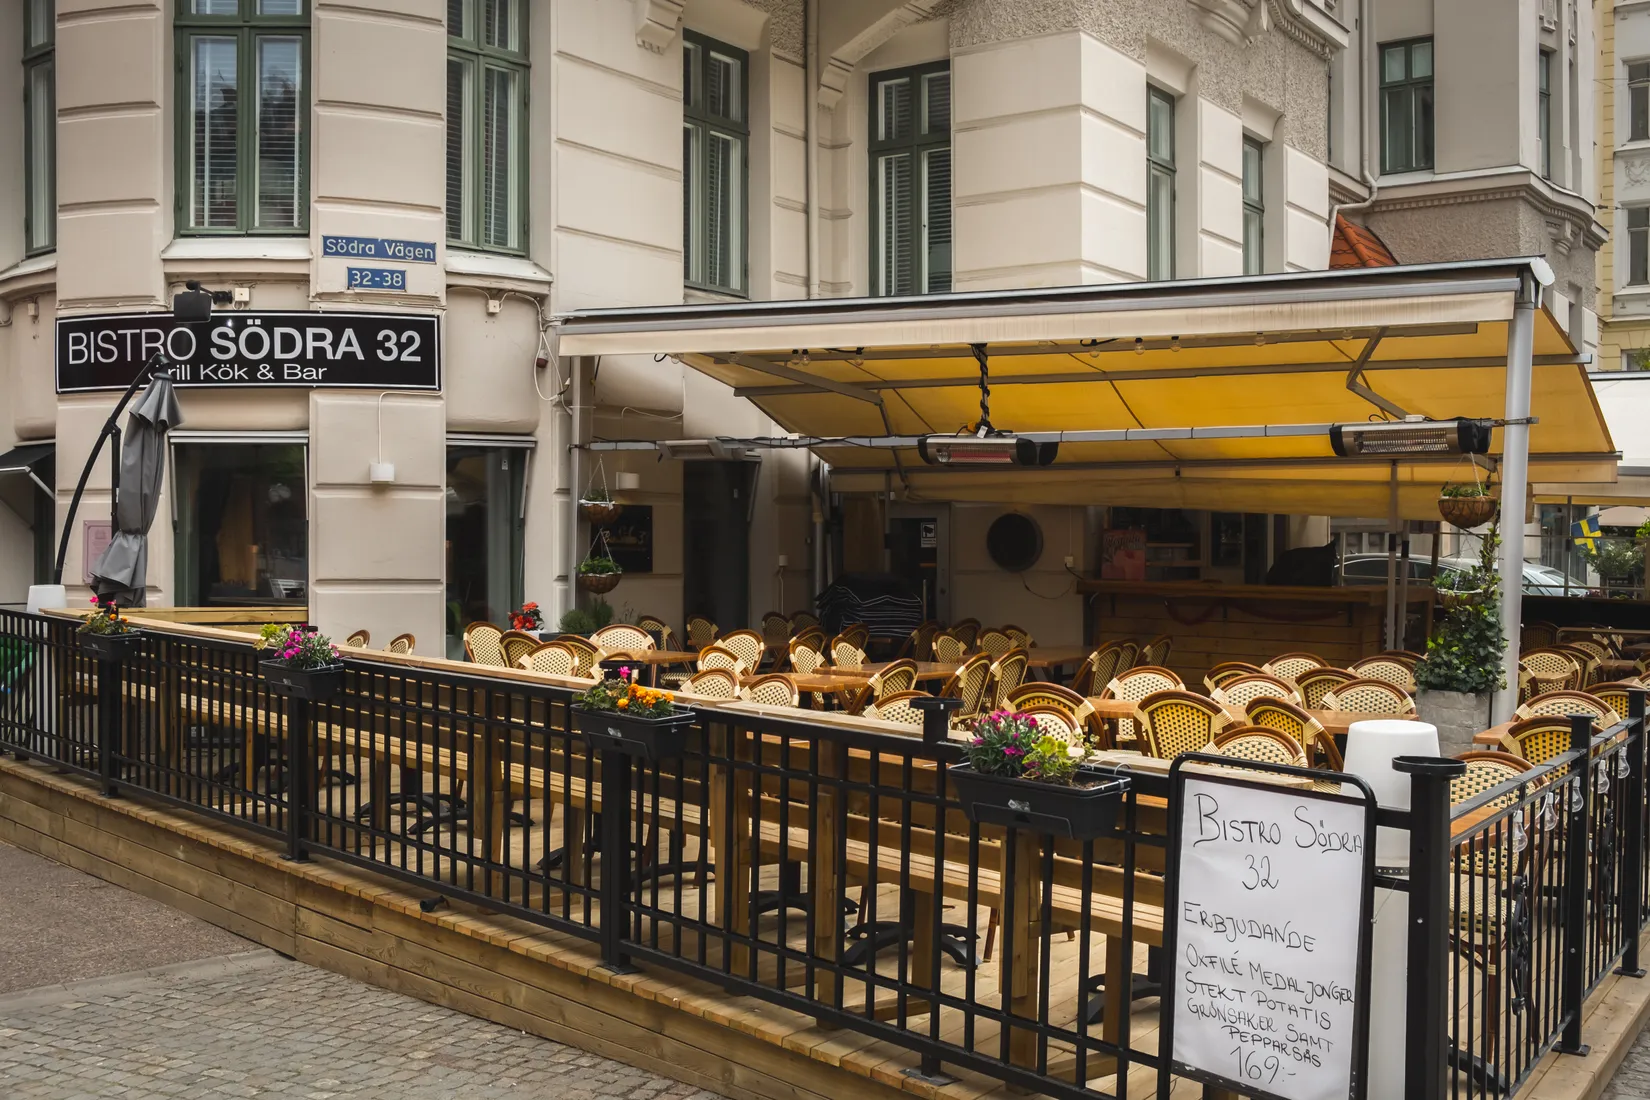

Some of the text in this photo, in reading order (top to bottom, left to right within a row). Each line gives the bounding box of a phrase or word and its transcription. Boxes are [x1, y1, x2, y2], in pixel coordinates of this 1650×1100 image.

[326, 239, 434, 260] Södra Vägen
[351, 270, 402, 286] 32-38
[69, 319, 421, 364] BISTRO SÖDRA 32
[147, 363, 327, 381] rill Kök & Bar
[1193, 793, 1362, 855] BISTRO SÖDRA
[1242, 854, 1279, 890] 32
[1184, 901, 1316, 952] ERBJUDANDE
[1186, 943, 1243, 976] OXFILÉ
[1185, 971, 1331, 1030] STEKT POTATIS
[1221, 1024, 1322, 1068] PEPPARSÅS
[1285, 1023, 1334, 1053] SAMT
[1230, 1045, 1297, 1084] 169:-
